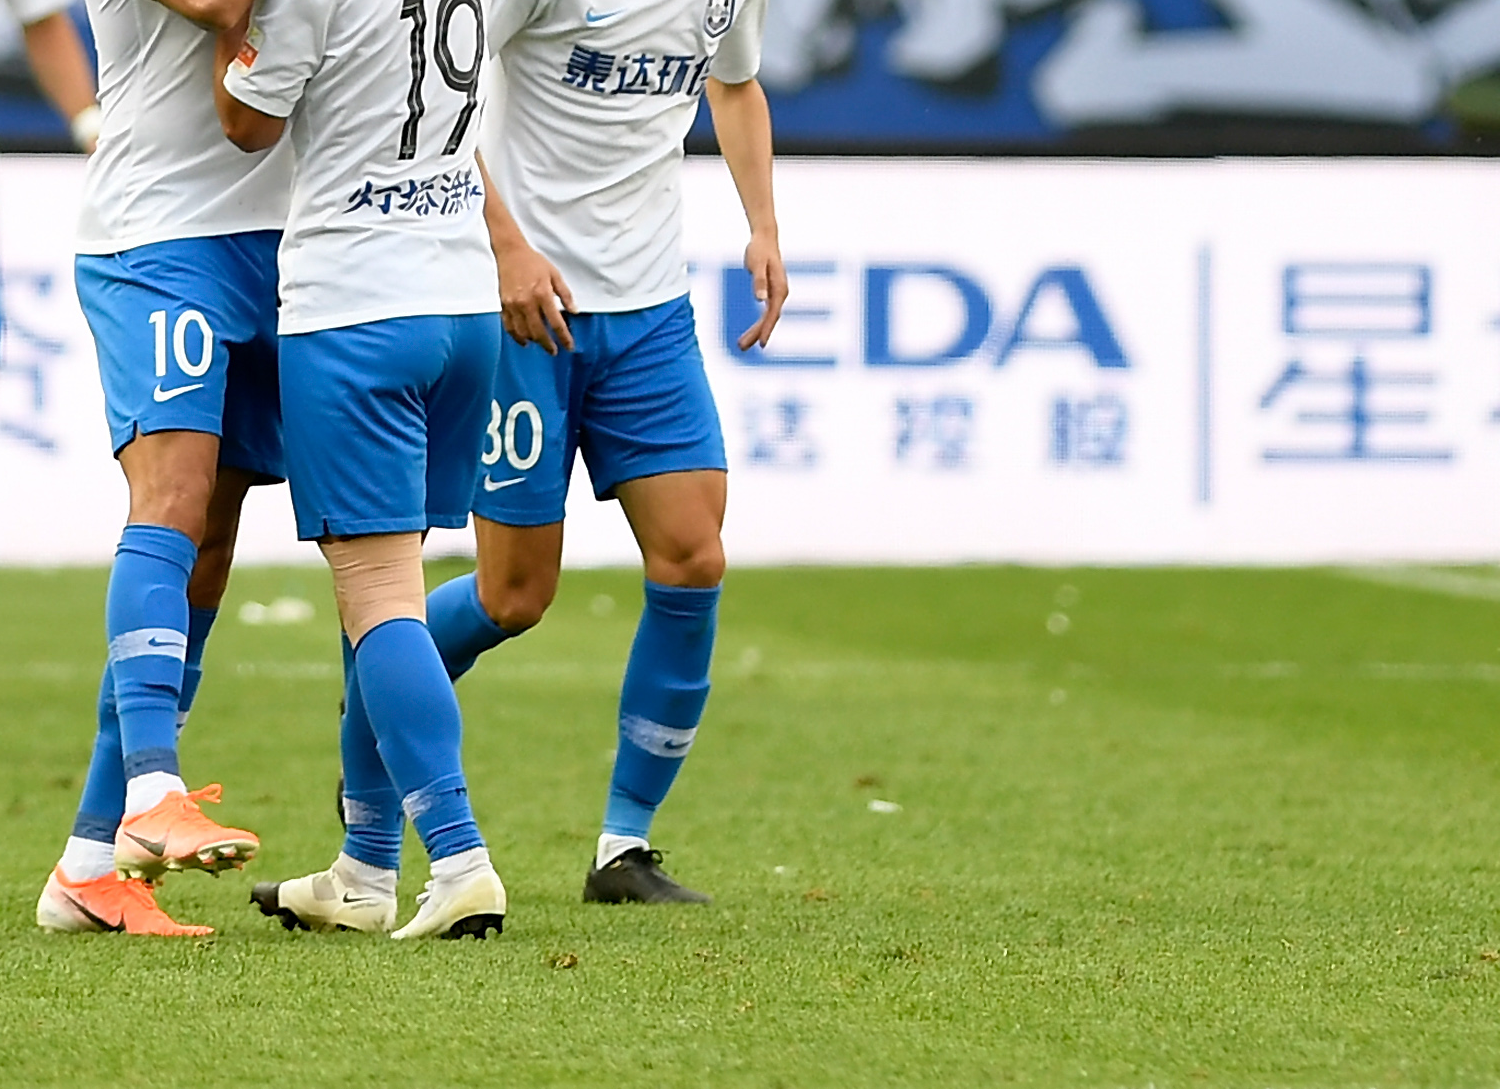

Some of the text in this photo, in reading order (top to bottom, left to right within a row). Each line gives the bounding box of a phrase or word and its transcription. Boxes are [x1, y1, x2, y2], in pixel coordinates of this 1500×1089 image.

[148, 309, 213, 377] 10
[686, 260, 1134, 368] EDA
[1258, 261, 1500, 461] 星
